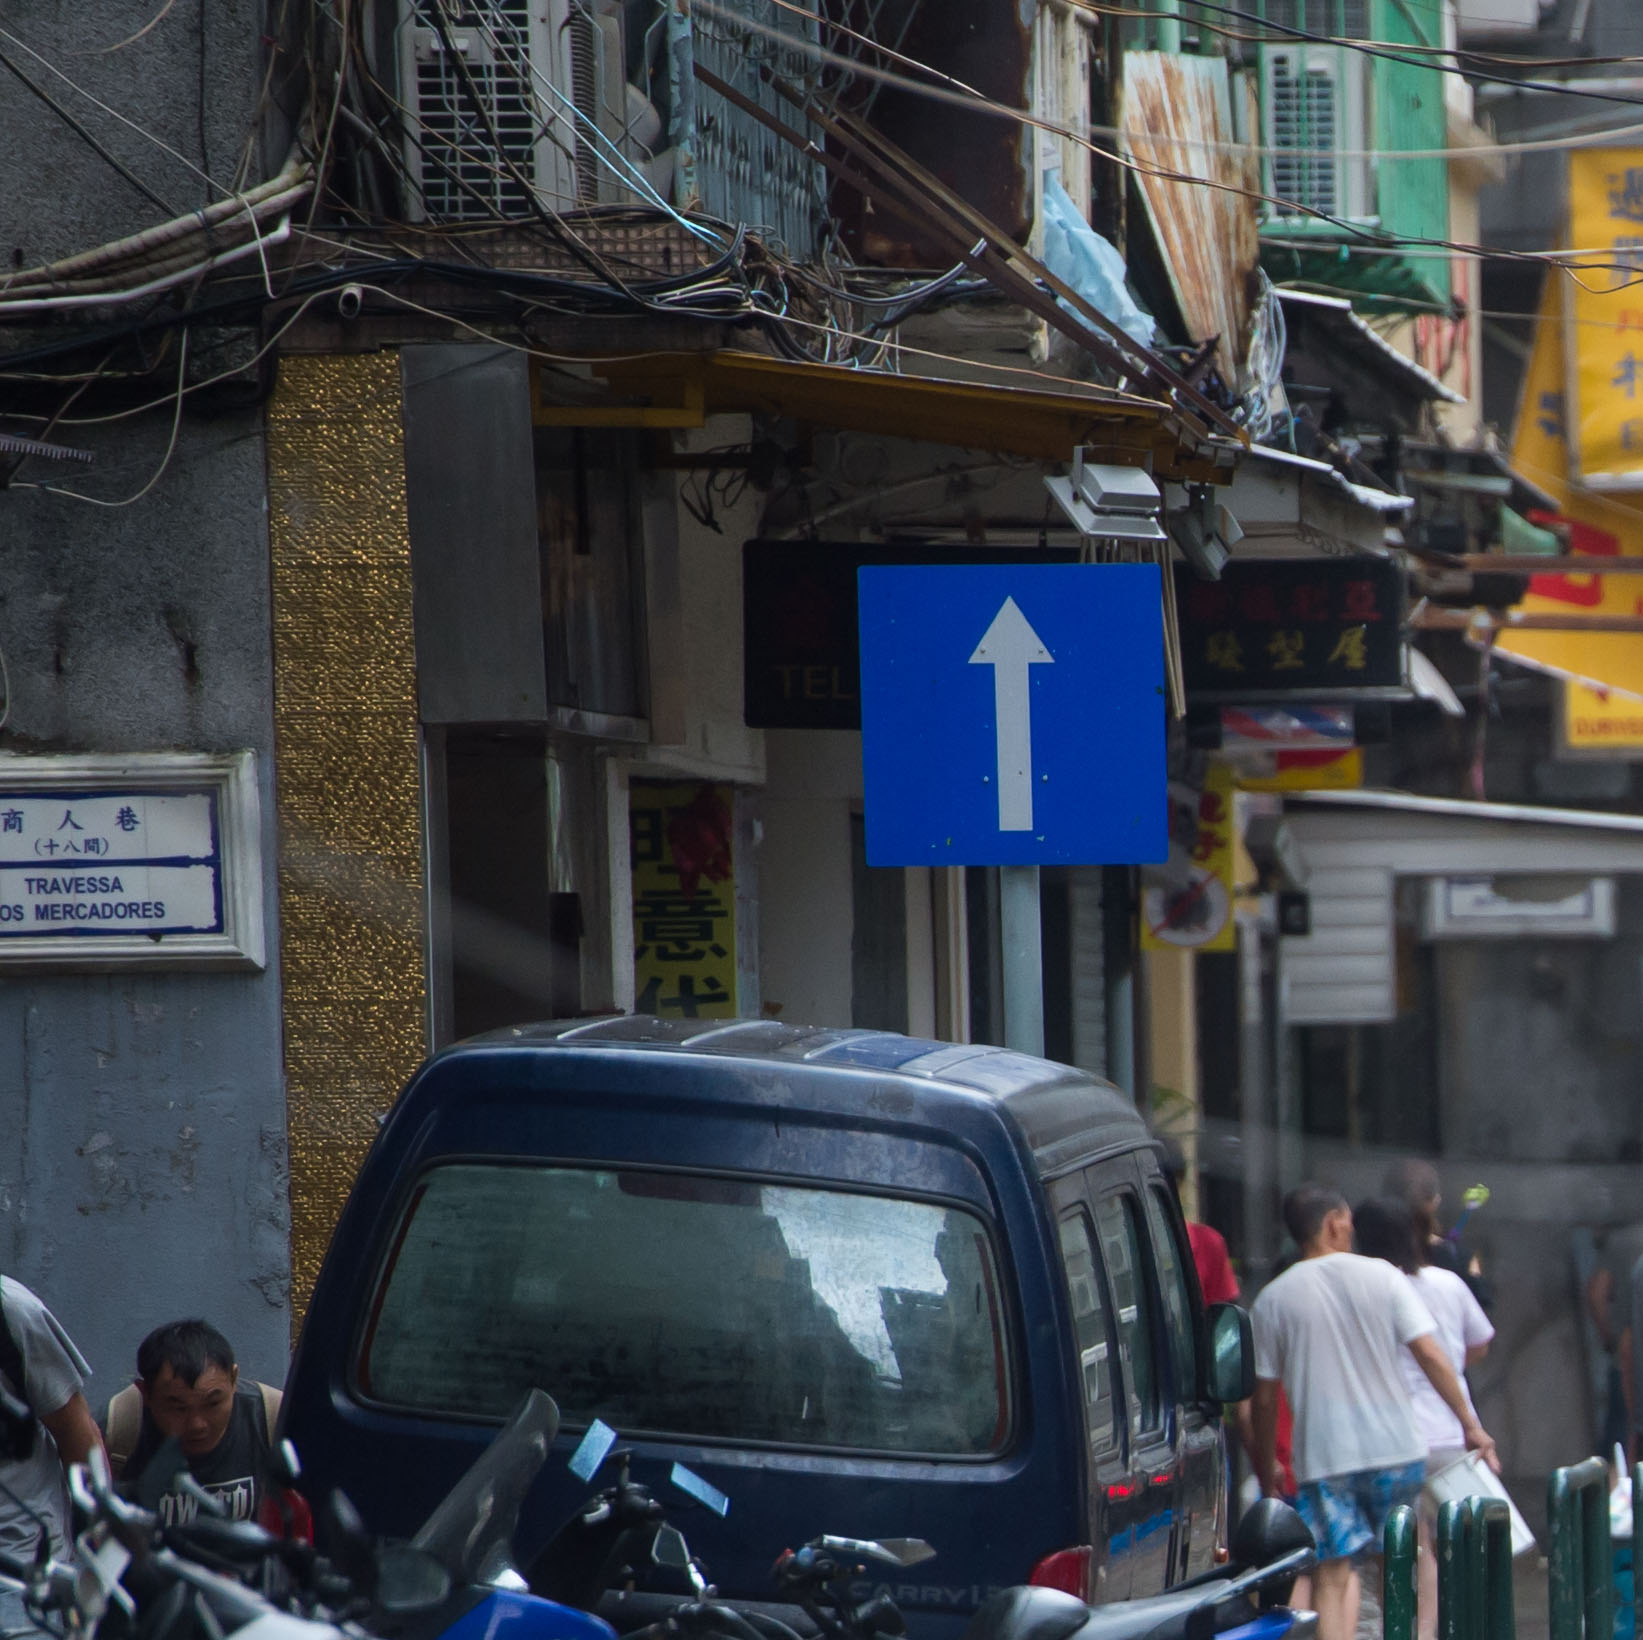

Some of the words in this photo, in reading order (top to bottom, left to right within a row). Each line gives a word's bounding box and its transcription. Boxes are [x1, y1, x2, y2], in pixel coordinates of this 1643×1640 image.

[1, 806, 141, 834] 商人巷
[24, 875, 124, 895] TRAVESSA
[34, 902, 166, 922] MERCADORES
[847, 1580, 968, 1606] CARRY
